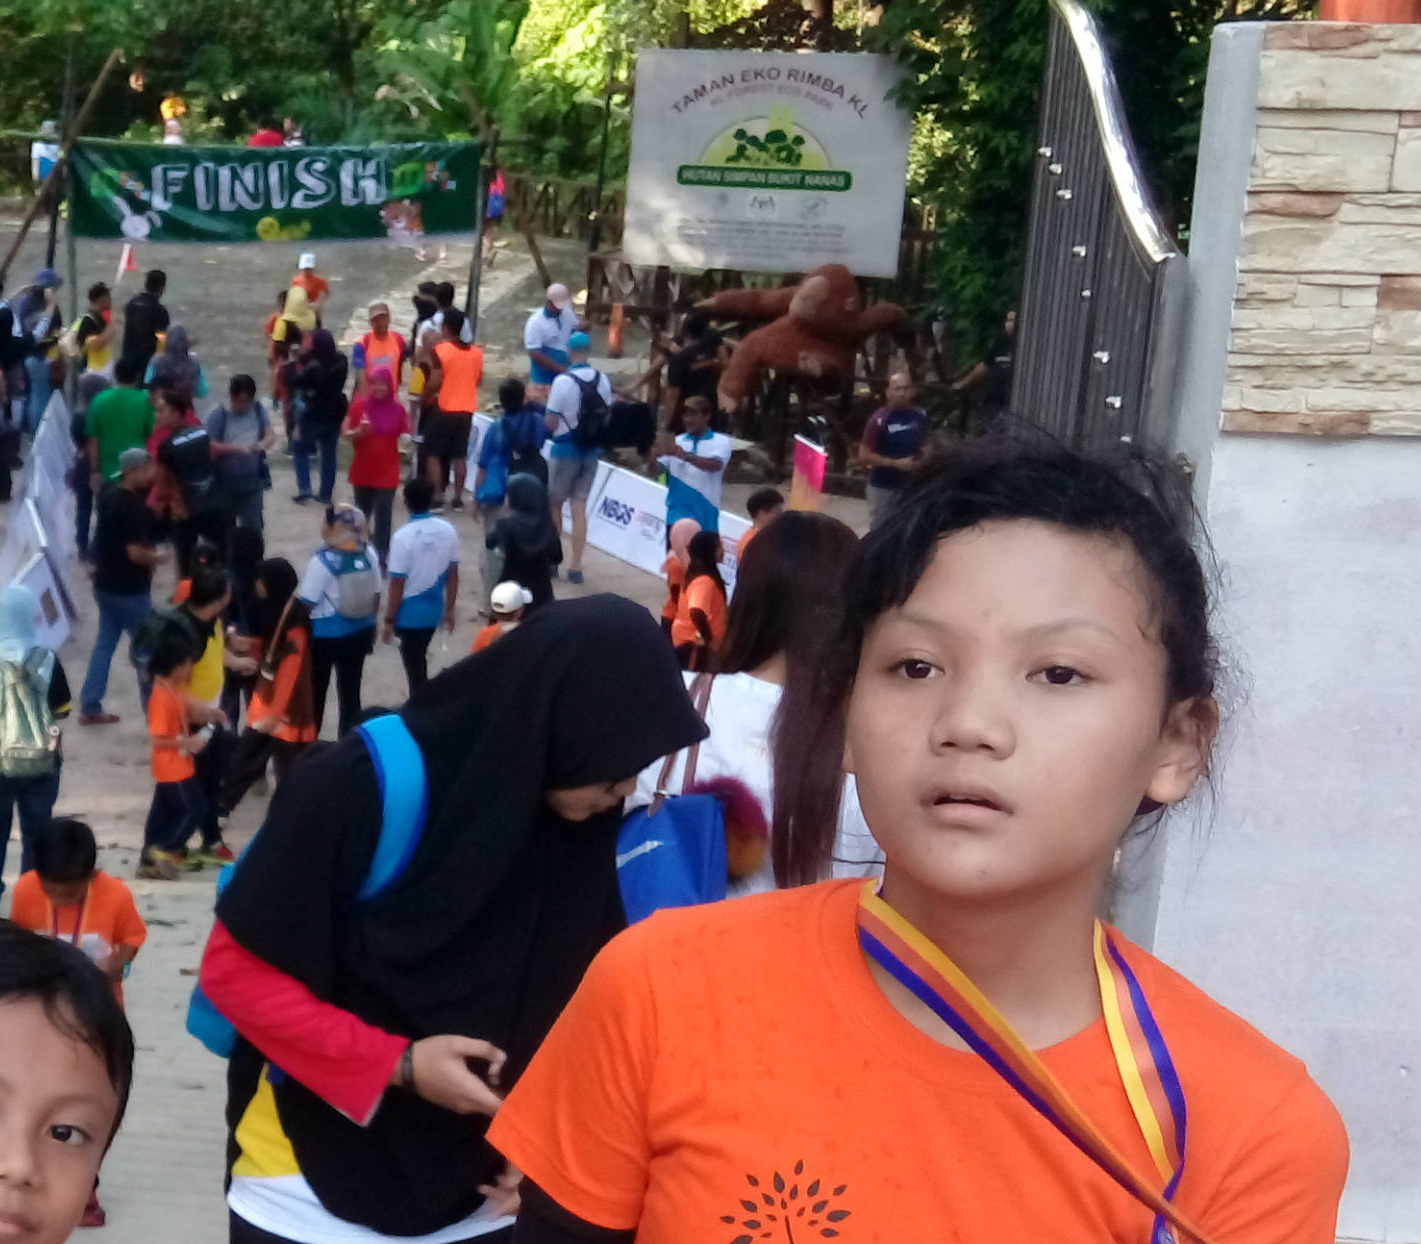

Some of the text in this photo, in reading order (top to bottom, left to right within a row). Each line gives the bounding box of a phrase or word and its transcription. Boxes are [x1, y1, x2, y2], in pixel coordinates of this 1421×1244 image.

[671, 67, 871, 119] TAMAN EKO RIMBA KL
[150, 156, 388, 212] FINISH
